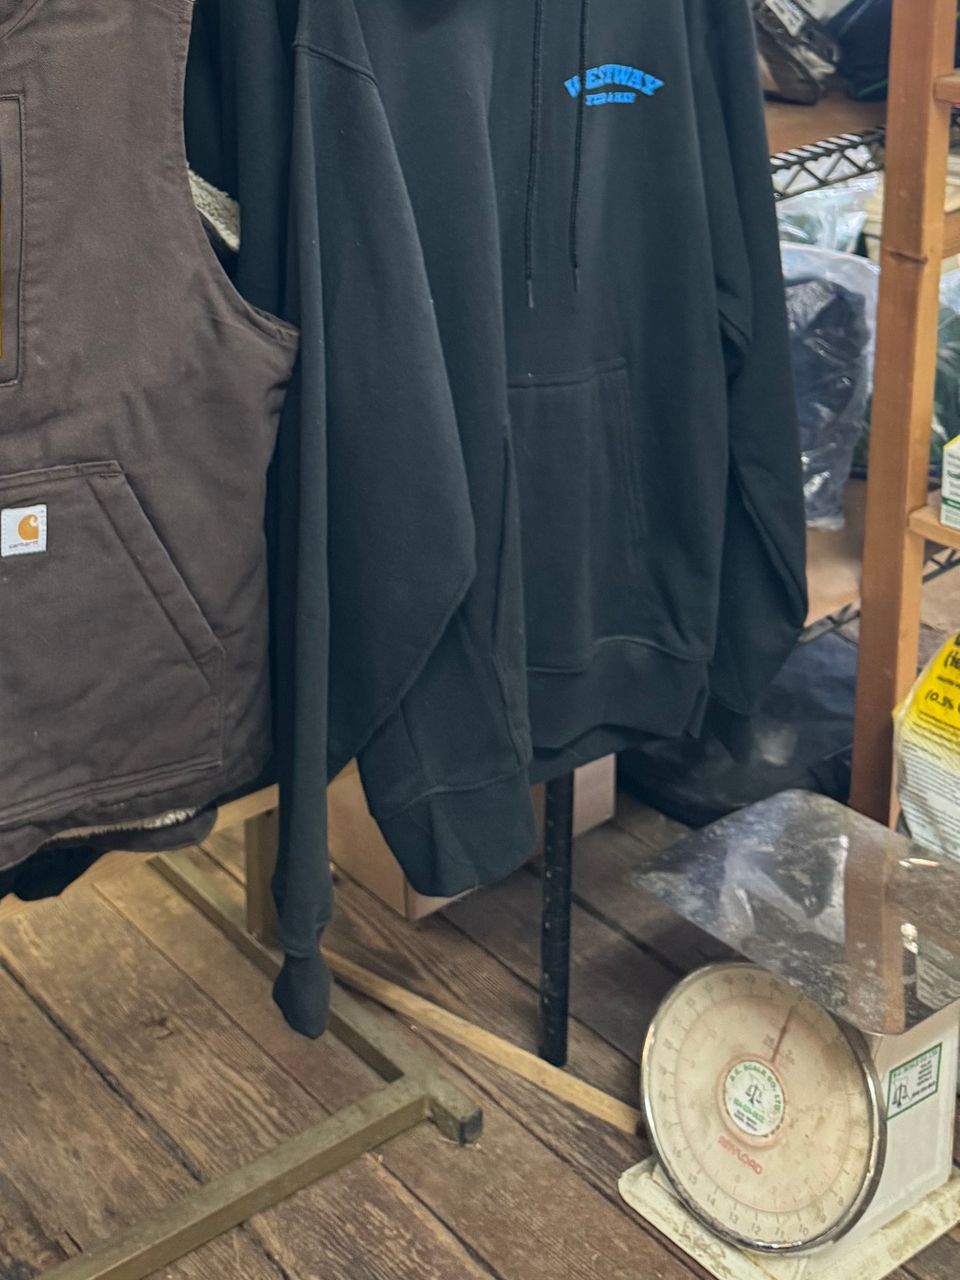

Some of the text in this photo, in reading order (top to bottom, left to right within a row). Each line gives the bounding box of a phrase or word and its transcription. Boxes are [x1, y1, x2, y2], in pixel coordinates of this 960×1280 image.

[564, 63, 665, 98] WESTWAY
[750, 1224, 762, 1235] 12
[798, 1223, 809, 1236] 10
